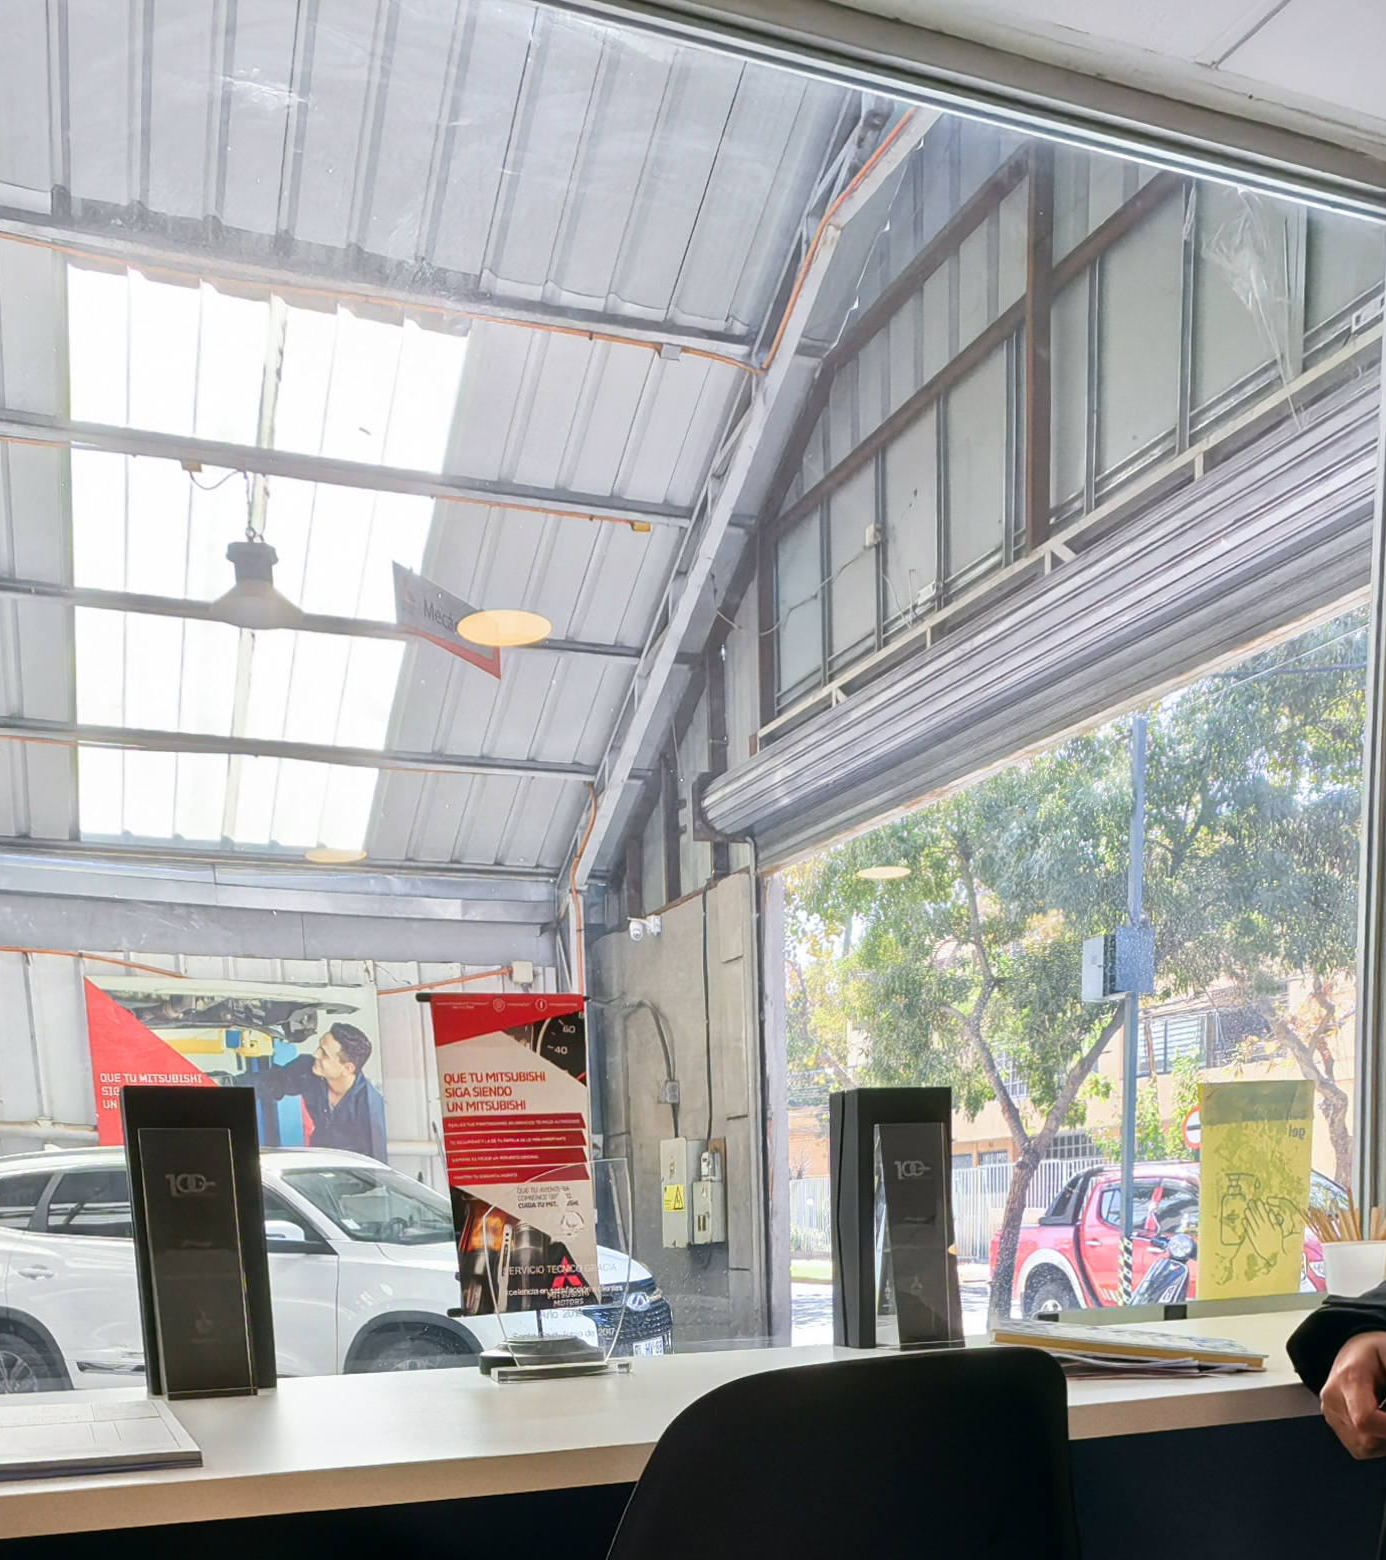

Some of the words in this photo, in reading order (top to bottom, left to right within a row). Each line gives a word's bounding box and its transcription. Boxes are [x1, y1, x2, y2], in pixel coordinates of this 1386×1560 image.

[423, 598, 458, 632] Mecá
[554, 1046, 568, 1055] 40
[100, 1073, 121, 1083] QUE
[122, 1073, 137, 1083] TU
[139, 1073, 203, 1084] MITSUBISHI
[443, 1072, 466, 1085] QUE
[468, 1072, 484, 1083] TU
[485, 1071, 546, 1083] MITSUBISHI
[445, 1087, 471, 1099] SIGA
[473, 1086, 512, 1097] SIENDO
[446, 1101, 464, 1112] UN
[466, 1100, 527, 1112] MITSUBISHI
